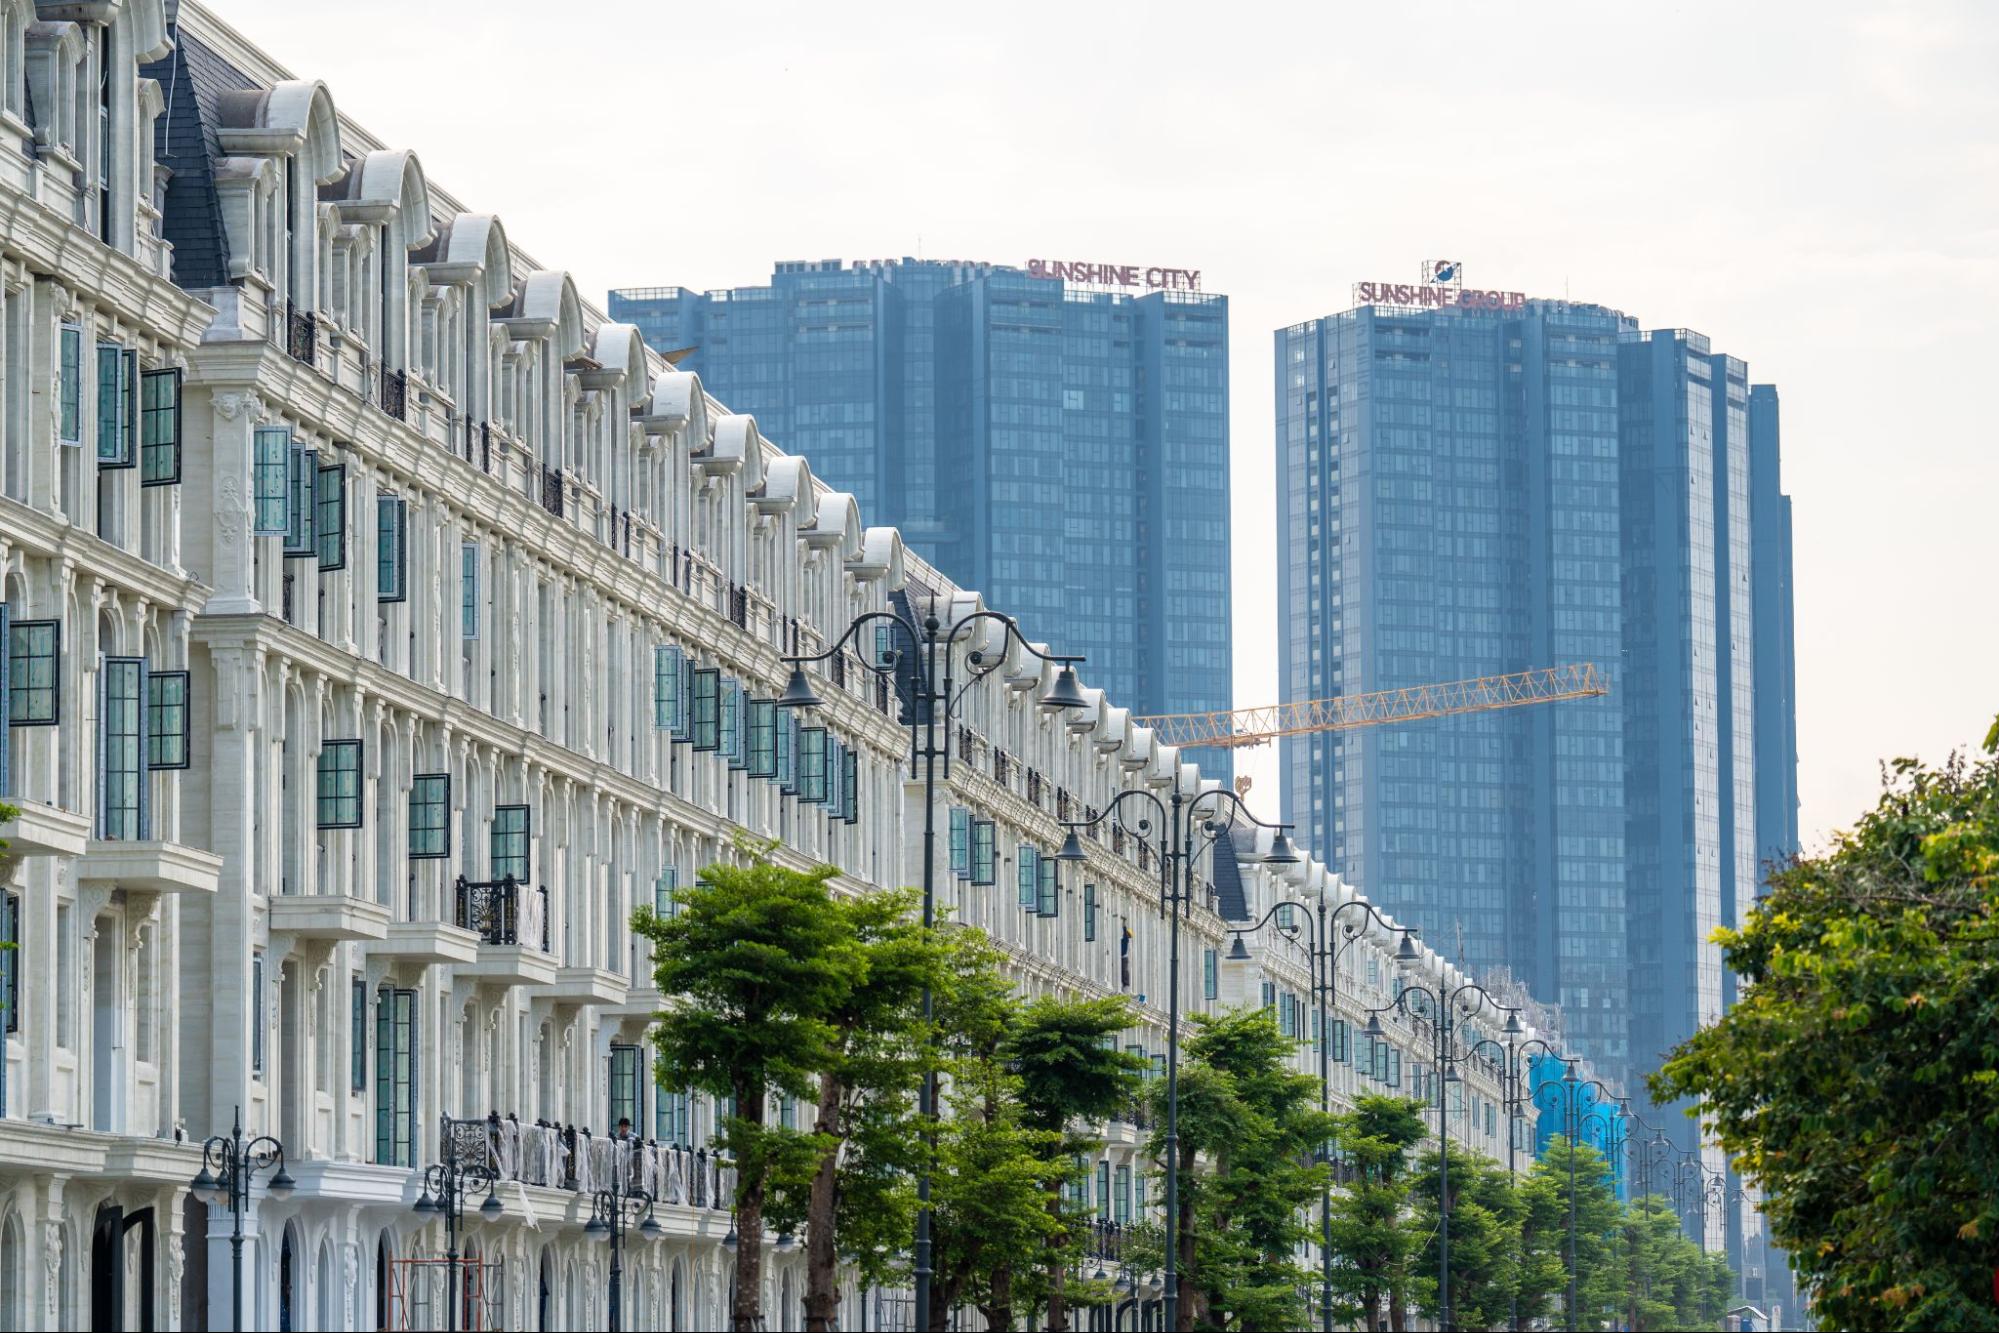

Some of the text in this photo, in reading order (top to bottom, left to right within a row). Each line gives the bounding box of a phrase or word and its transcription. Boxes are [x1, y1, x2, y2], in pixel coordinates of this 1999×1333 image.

[1028, 258, 1201, 290] SUNSHINE CITY
[1360, 281, 1526, 311] SUNSHINE GROUP
